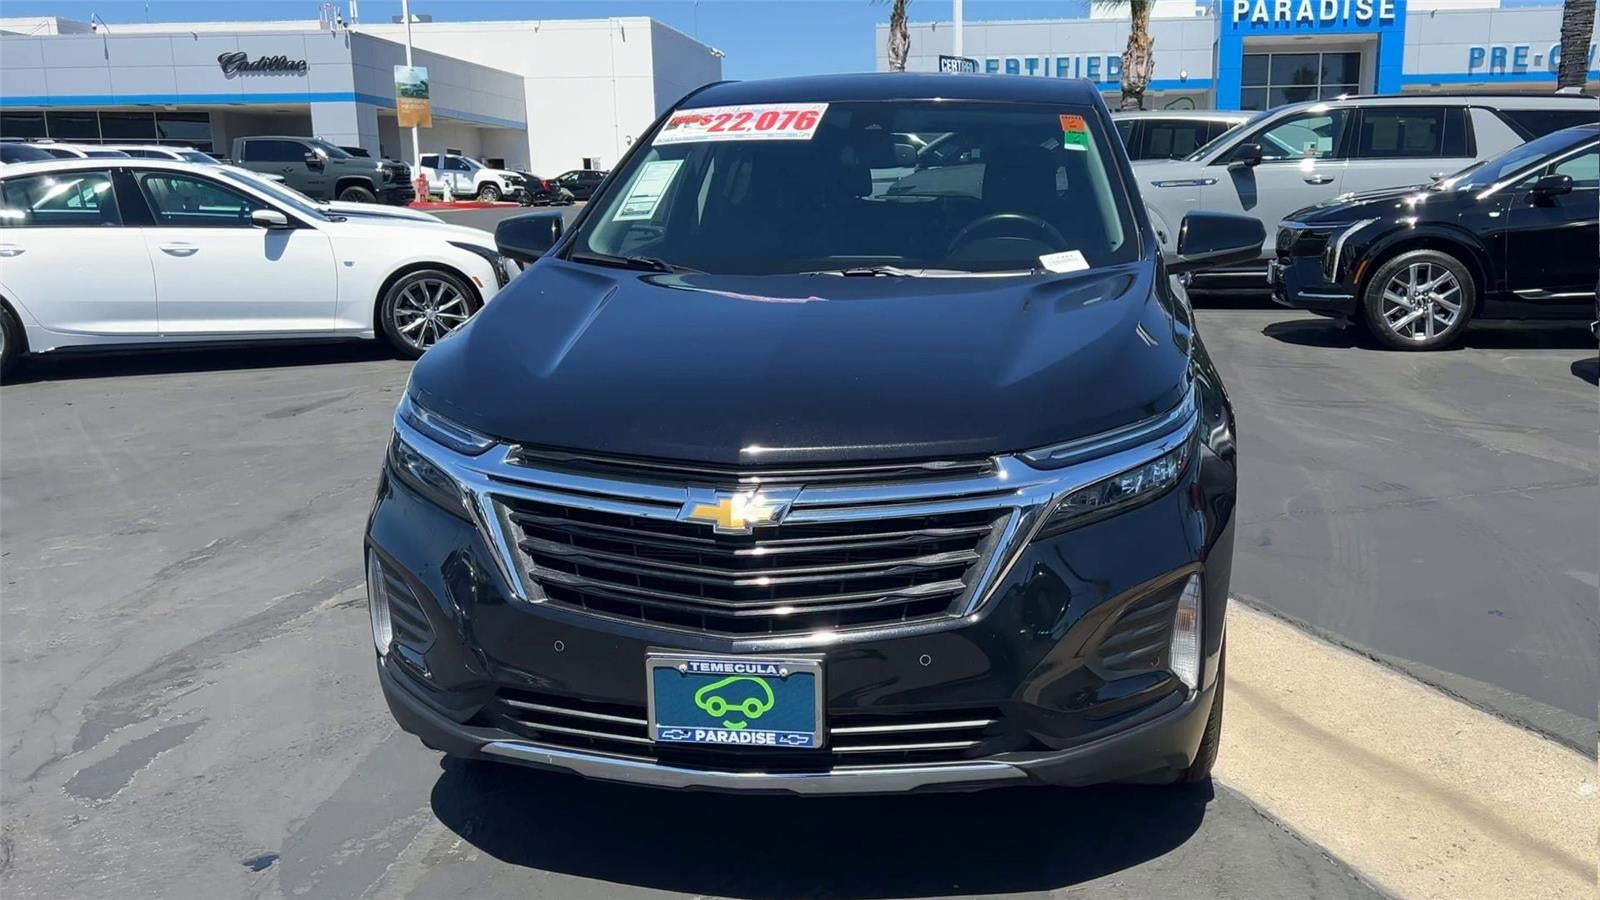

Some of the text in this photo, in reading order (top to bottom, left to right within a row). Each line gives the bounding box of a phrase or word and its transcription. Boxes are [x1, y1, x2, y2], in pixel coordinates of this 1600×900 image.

[1233, 0, 1396, 21] PARADISE
[217, 51, 307, 75] Cadillac
[975, 56, 1121, 81] ERTIFIED
[699, 110, 819, 133] $22,076
[690, 661, 778, 675] TEMECULA
[695, 729, 776, 745] PARADISE
